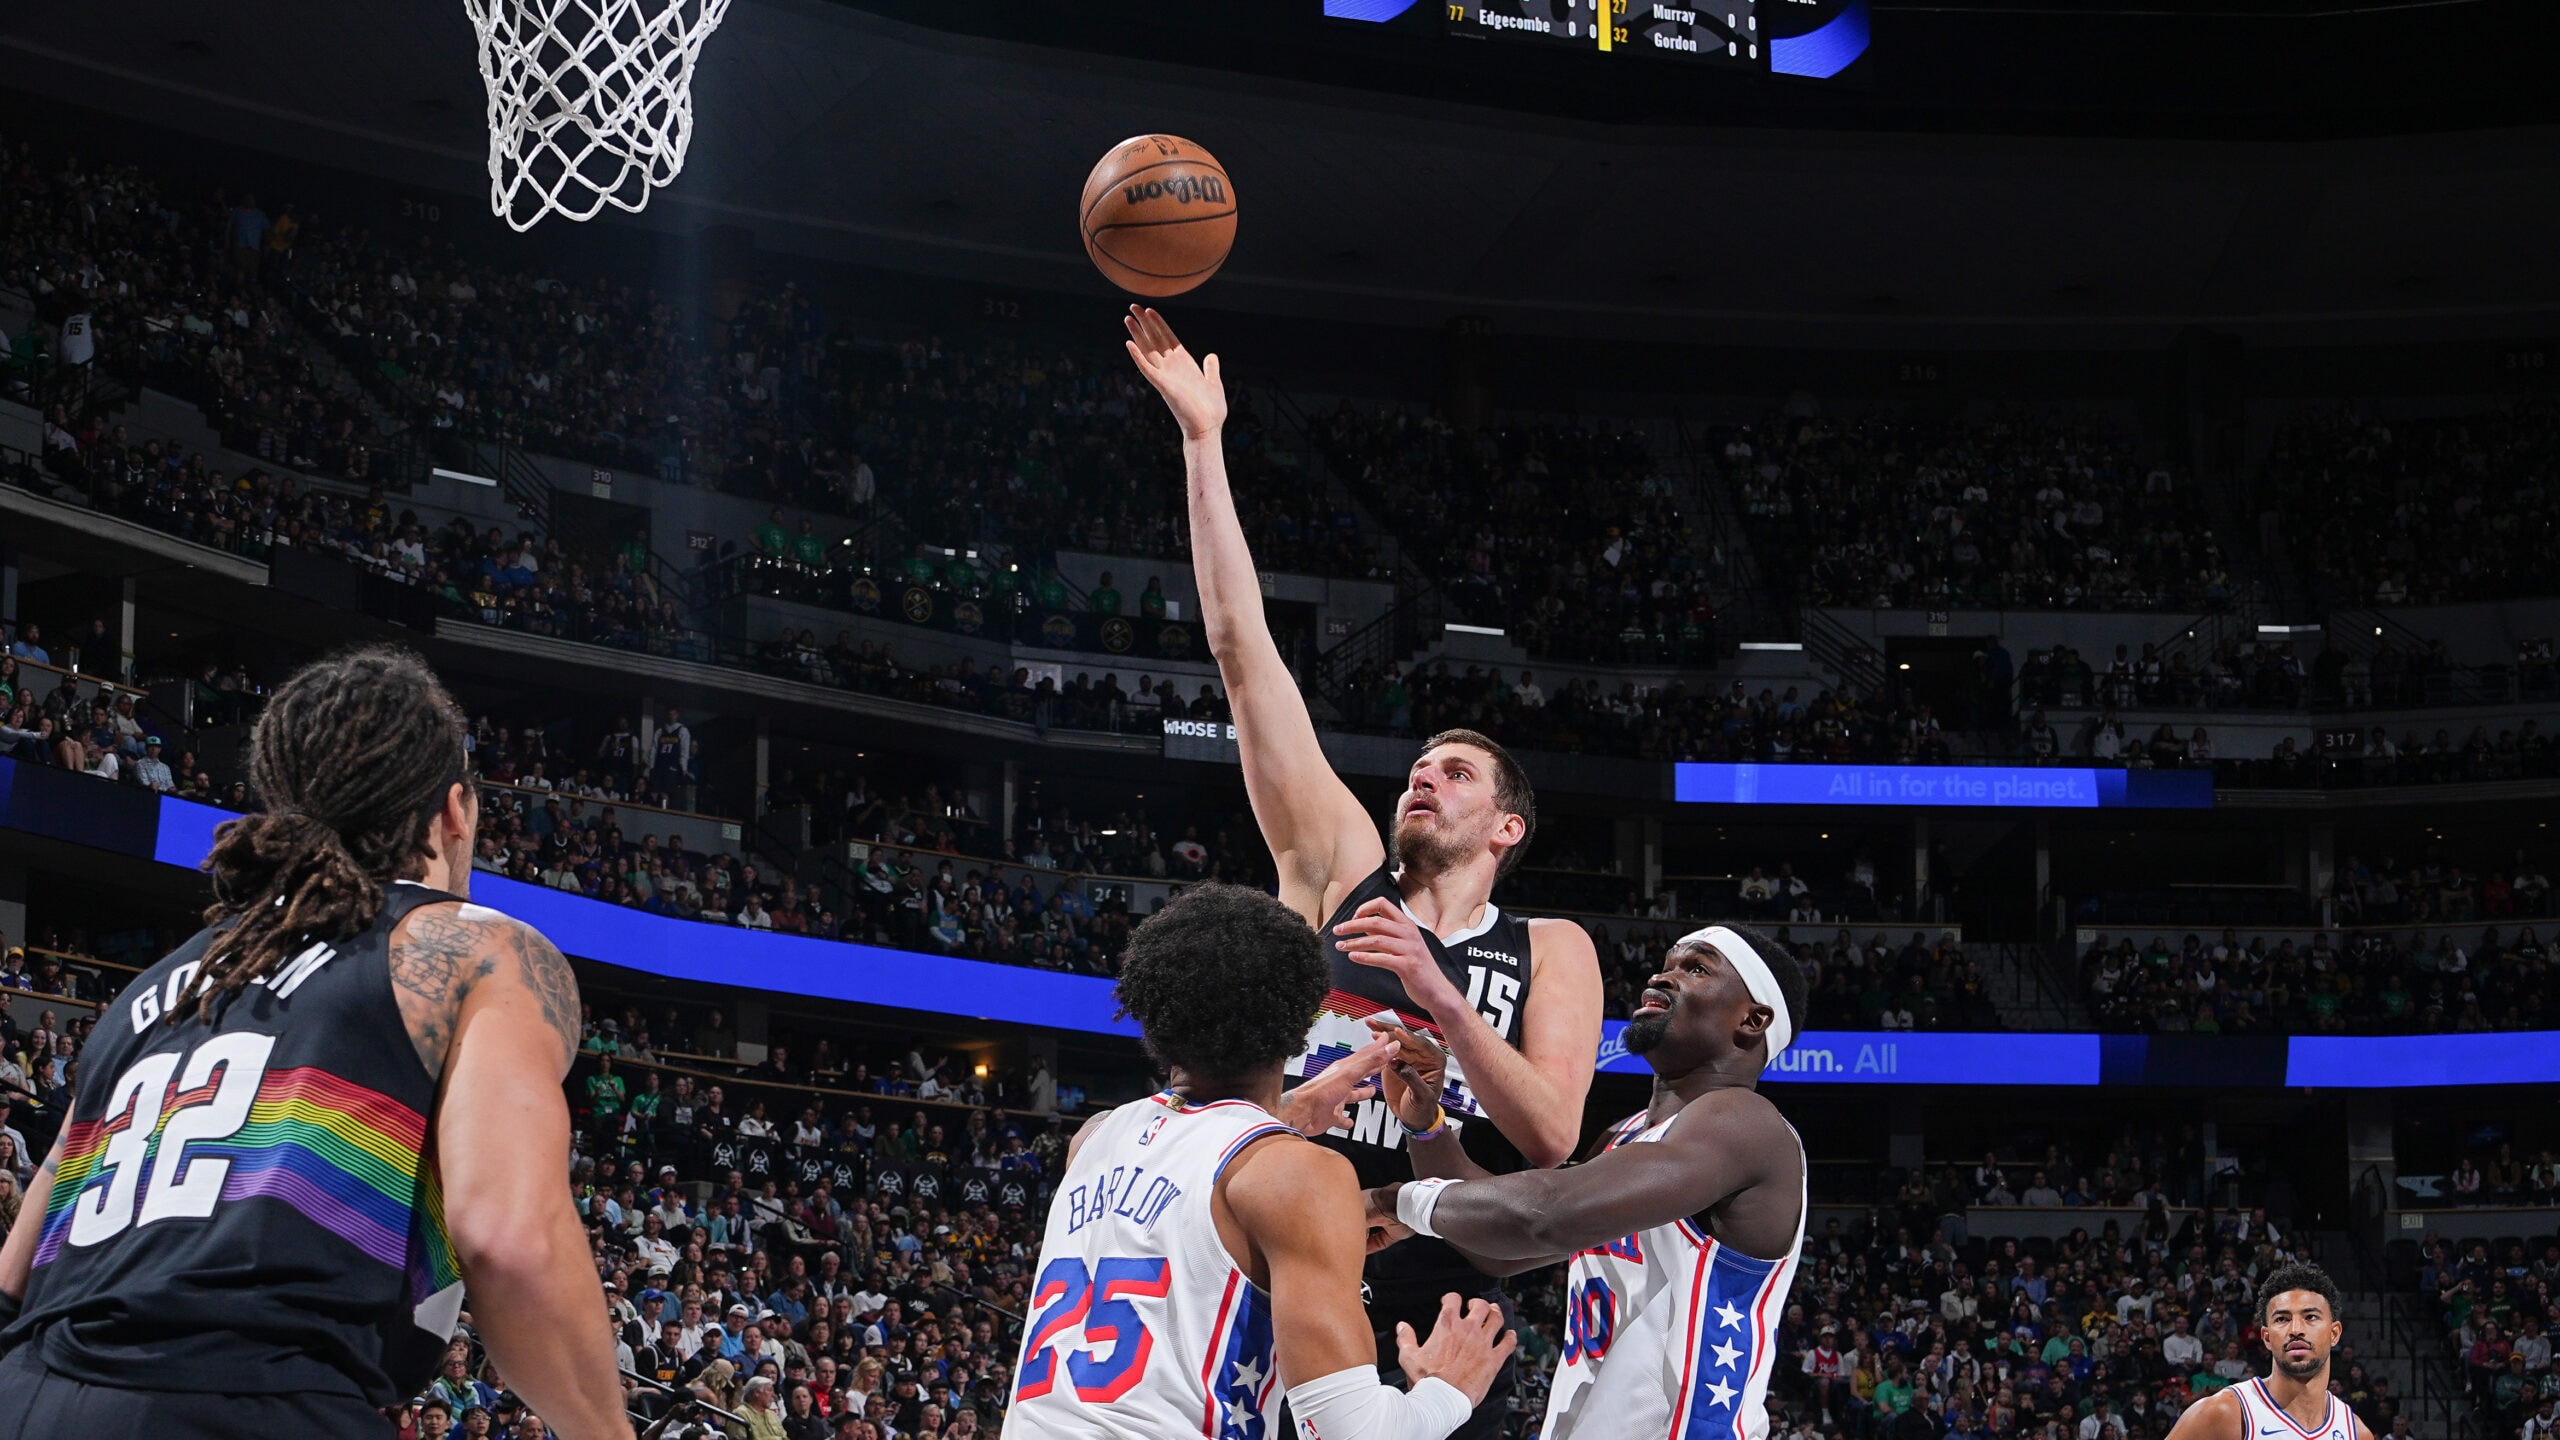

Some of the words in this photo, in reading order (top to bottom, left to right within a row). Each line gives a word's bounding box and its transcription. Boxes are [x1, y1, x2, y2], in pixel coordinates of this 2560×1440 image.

[1449, 5, 1465, 21] 77
[1479, 9, 1550, 33] Edgecombe
[1568, 21, 1576, 36] 0
[1589, 24, 1597, 39] 0
[1612, 0, 1627, 14] 27
[1653, 4, 1696, 25] Murray
[1728, 13, 1736, 29] 0
[1748, 15, 1756, 31] 0
[1613, 27, 1629, 43] 32
[1654, 32, 1697, 52] Gordon
[1728, 41, 1737, 57] 0
[1749, 43, 1757, 59] 0
[1123, 175, 1227, 205] Wilson
[592, 469, 612, 483] 310
[689, 536, 709, 550] 312
[1163, 719, 1217, 738] WHOSE
[2325, 733, 2356, 747] 317
[1829, 773, 1862, 797] All
[1869, 772, 1892, 797] in
[1899, 773, 1937, 797] for
[1943, 774, 1987, 798] the
[1994, 775, 2085, 803] planet.
[1467, 946, 1518, 966] ibotta
[1466, 965, 1521, 1040] 15
[1854, 1043, 1897, 1074] All
[68, 1032, 276, 1247] 32
[1067, 1165, 1182, 1235] BARLOW
[1015, 1257, 1172, 1404] 25
[1564, 1276, 1616, 1367] 30
